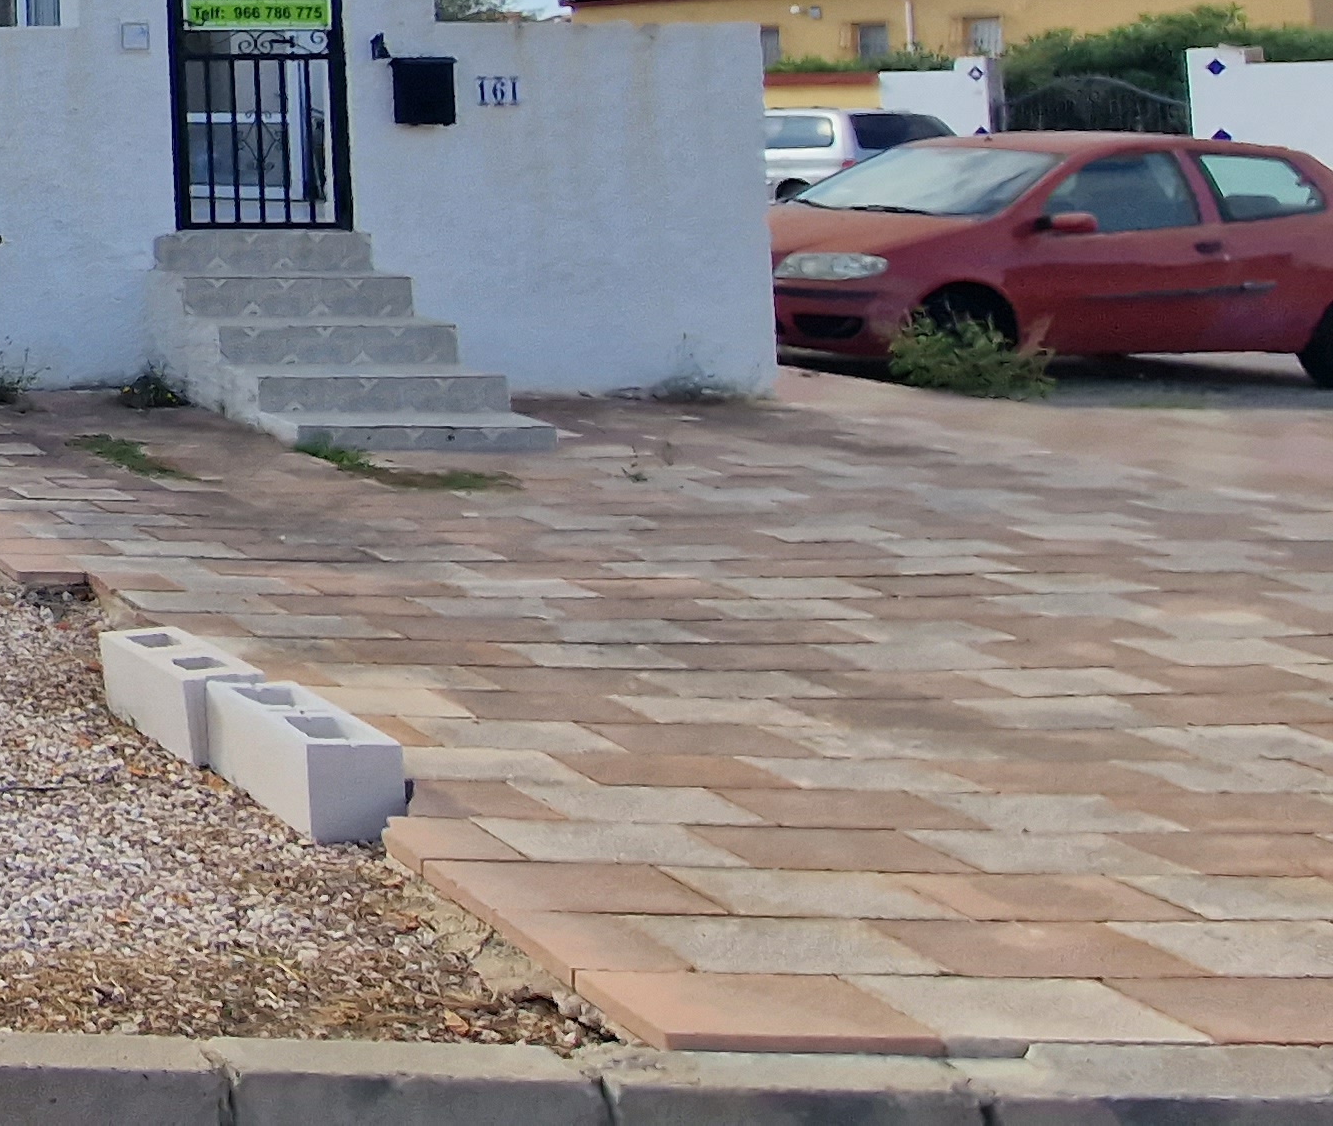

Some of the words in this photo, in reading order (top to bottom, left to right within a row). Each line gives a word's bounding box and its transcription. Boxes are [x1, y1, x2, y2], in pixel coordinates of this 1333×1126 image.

[193, 6, 225, 20] Telf:
[234, 7, 261, 19] 966
[266, 7, 292, 19] 786
[296, 7, 323, 19] 775
[477, 77, 518, 104] 161
